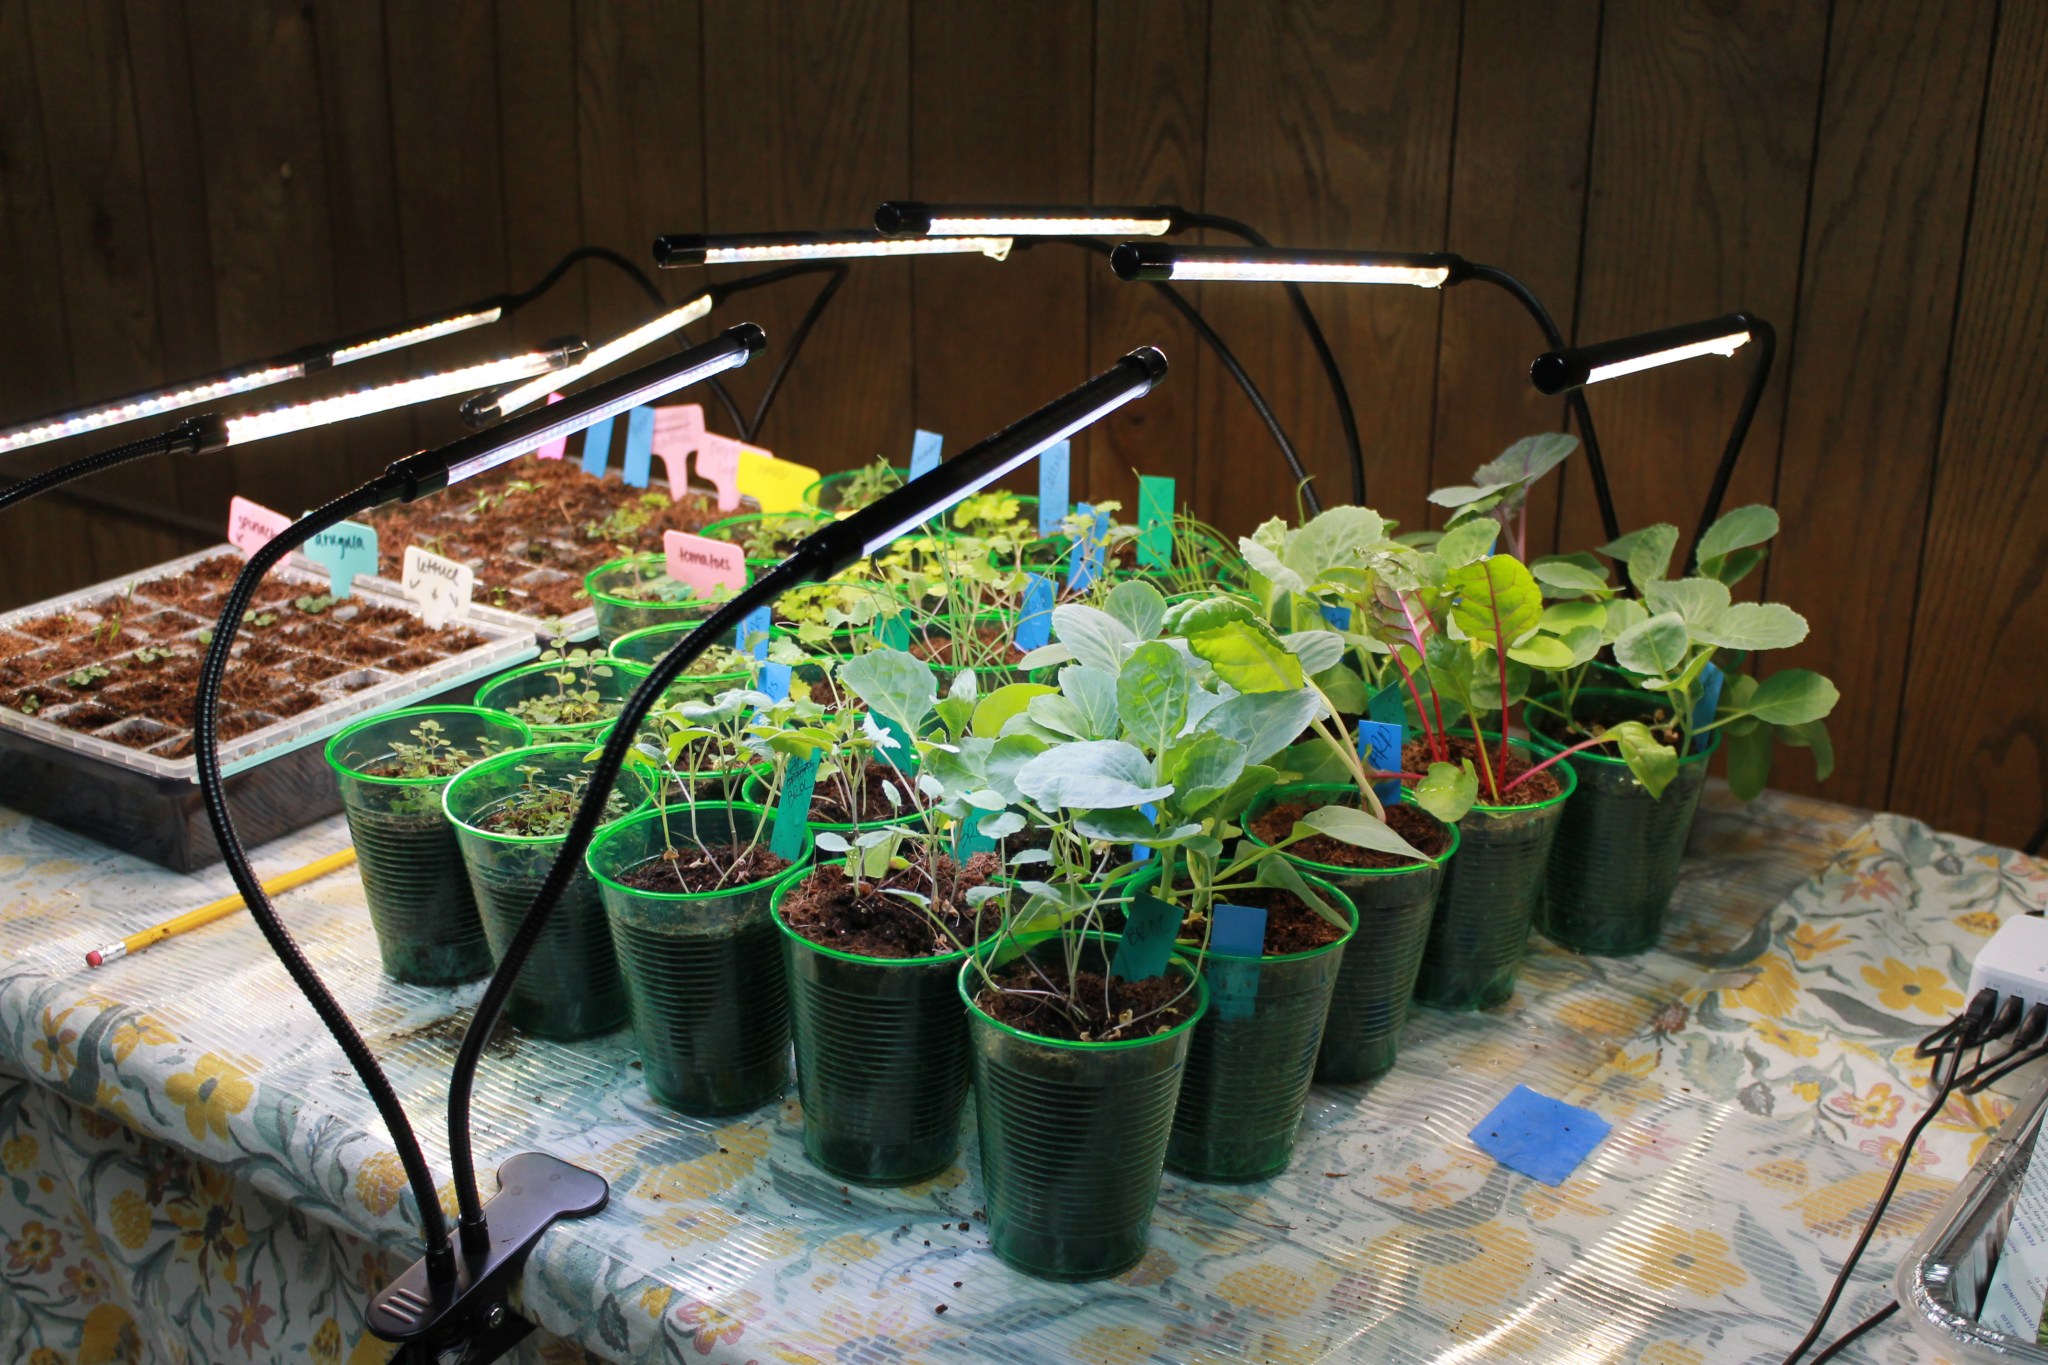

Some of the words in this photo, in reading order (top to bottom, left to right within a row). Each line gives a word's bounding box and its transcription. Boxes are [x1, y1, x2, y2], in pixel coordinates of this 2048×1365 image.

[315, 534, 366, 560] arugula
[679, 547, 732, 571] tomatoes
[416, 556, 459, 587] lettuce
[2016, 1220, 2036, 1247] PERSIAN
